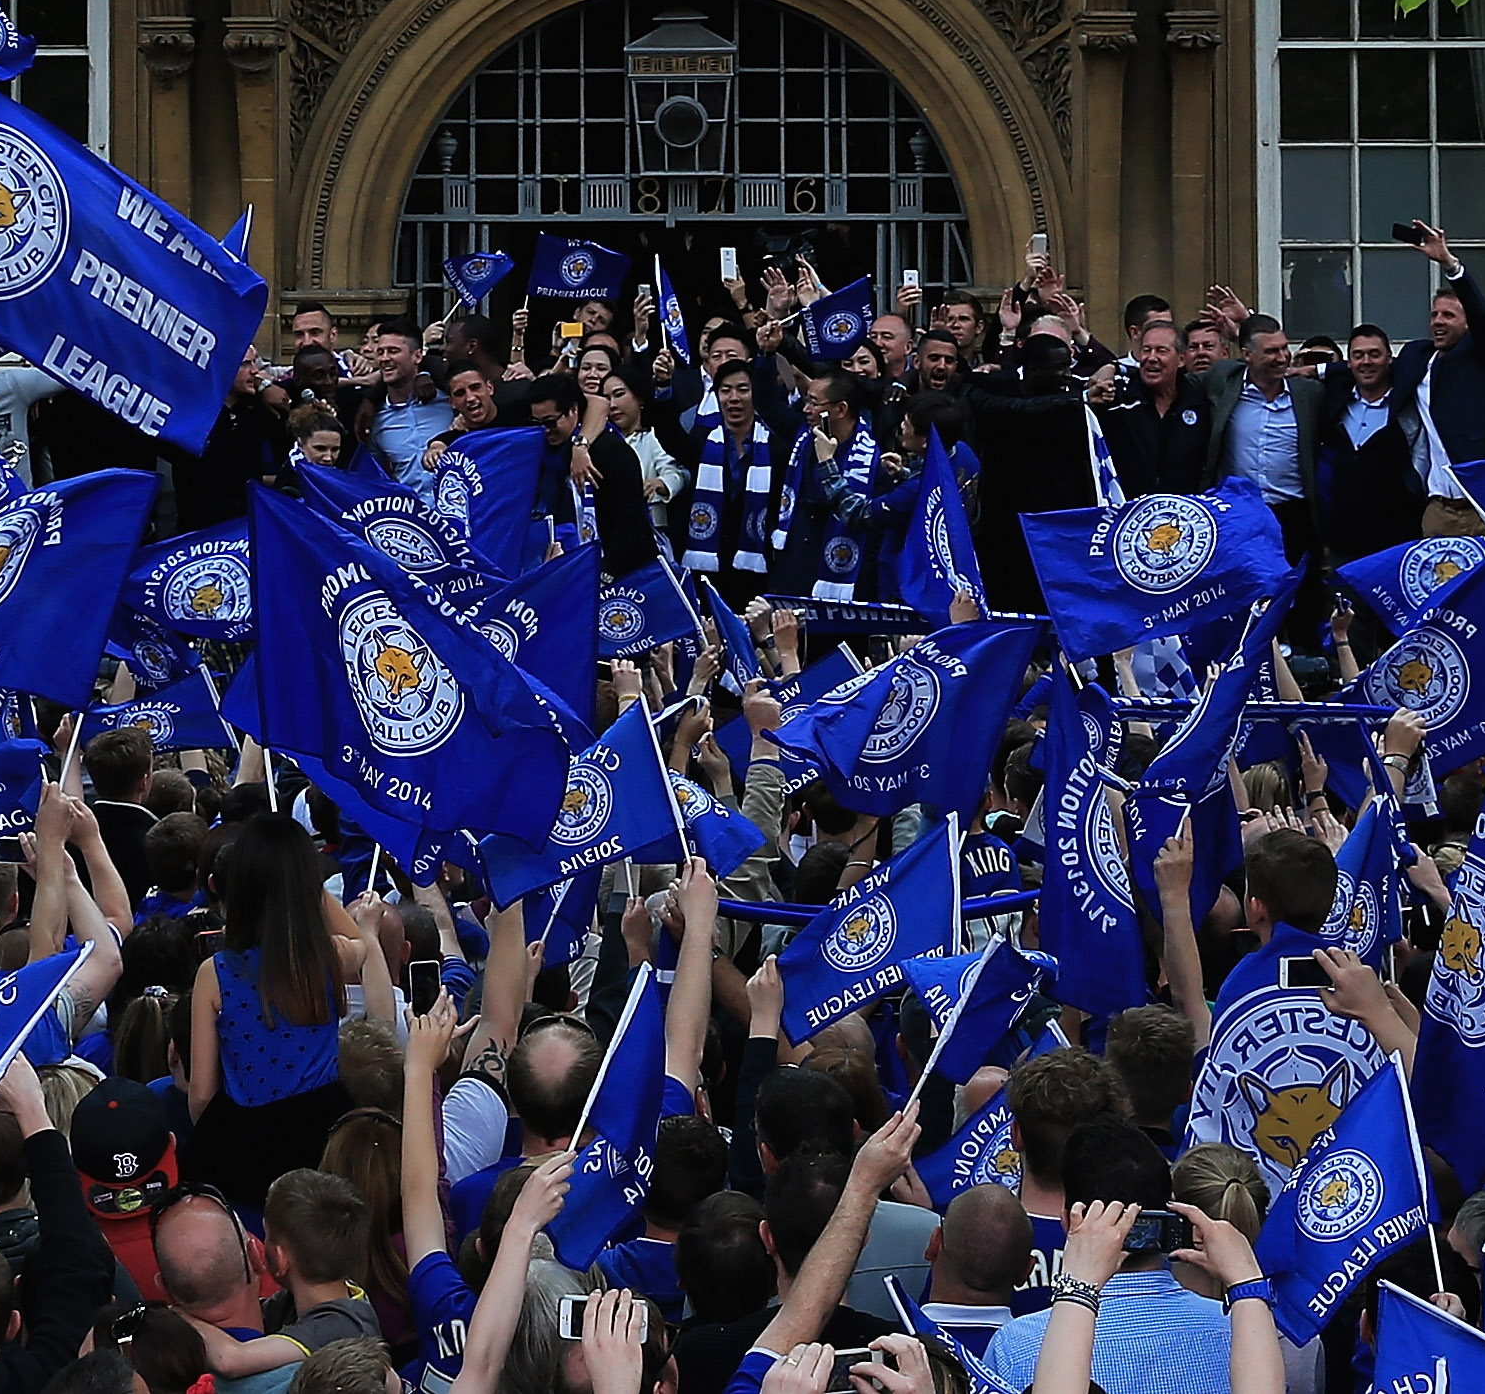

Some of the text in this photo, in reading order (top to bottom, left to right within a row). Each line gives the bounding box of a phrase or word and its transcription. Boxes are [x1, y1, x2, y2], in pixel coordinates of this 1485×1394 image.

[38, 183, 57, 240] CITY
[117, 186, 169, 244] WE
[70, 247, 217, 370] PREMIER
[42, 335, 171, 437] LEAGUE
[418, 505, 475, 569] 2013/14
[1122, 500, 1206, 553] LEICESTER CITY
[1126, 531, 1209, 584] FOOTBALL CLUB
[449, 573, 484, 594] 2014
[1162, 584, 1226, 622] MAY 2014
[345, 604, 403, 648] LEICES
[1259, 661, 1271, 682] WE
[413, 699, 451, 741] CLUB
[386, 777, 433, 811] 2014
[1125, 799, 1147, 841] 2014
[965, 845, 1011, 878] KING
[113, 1153, 140, 1179] B
